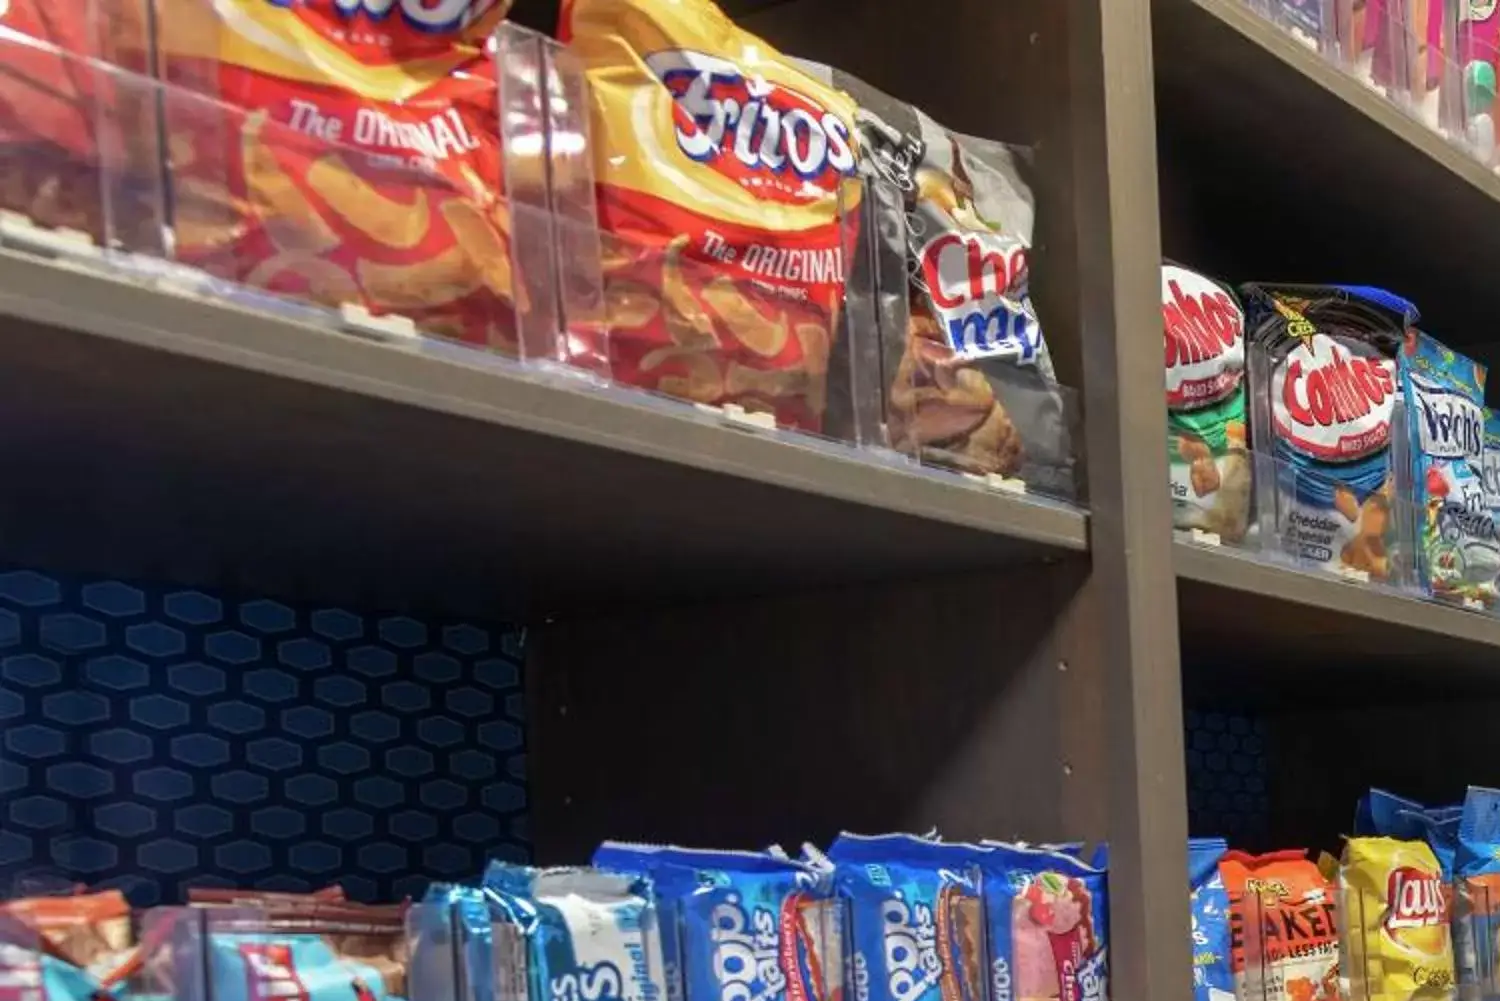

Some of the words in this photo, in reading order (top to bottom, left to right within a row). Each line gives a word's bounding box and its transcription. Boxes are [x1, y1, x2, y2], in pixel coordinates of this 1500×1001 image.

[289, 97, 343, 141] The
[662, 52, 857, 180] Fritos
[702, 229, 738, 264] The
[741, 243, 845, 284] ORIGINAL
[1282, 344, 1394, 427] Combos
[1388, 870, 1446, 929] Lay's
